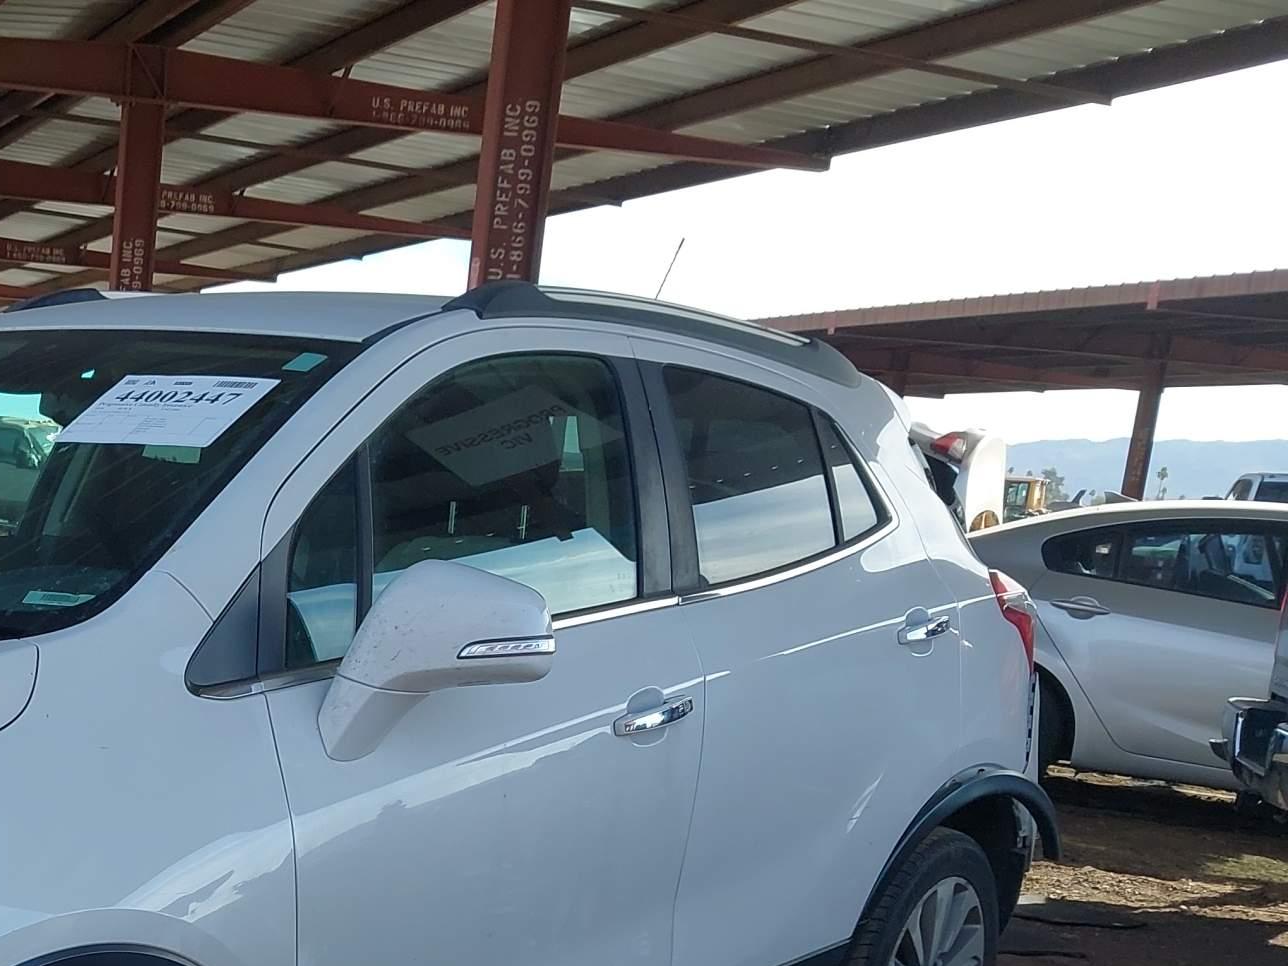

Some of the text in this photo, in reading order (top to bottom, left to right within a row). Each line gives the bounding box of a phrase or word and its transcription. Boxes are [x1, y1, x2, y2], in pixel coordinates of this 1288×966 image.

[399, 99, 446, 115] PREFAB
[493, 148, 517, 229] PREFAB
[506, 100, 541, 280] 1-866-799-0969
[488, 241, 508, 280] U.S.
[115, 390, 245, 405] 44002447
